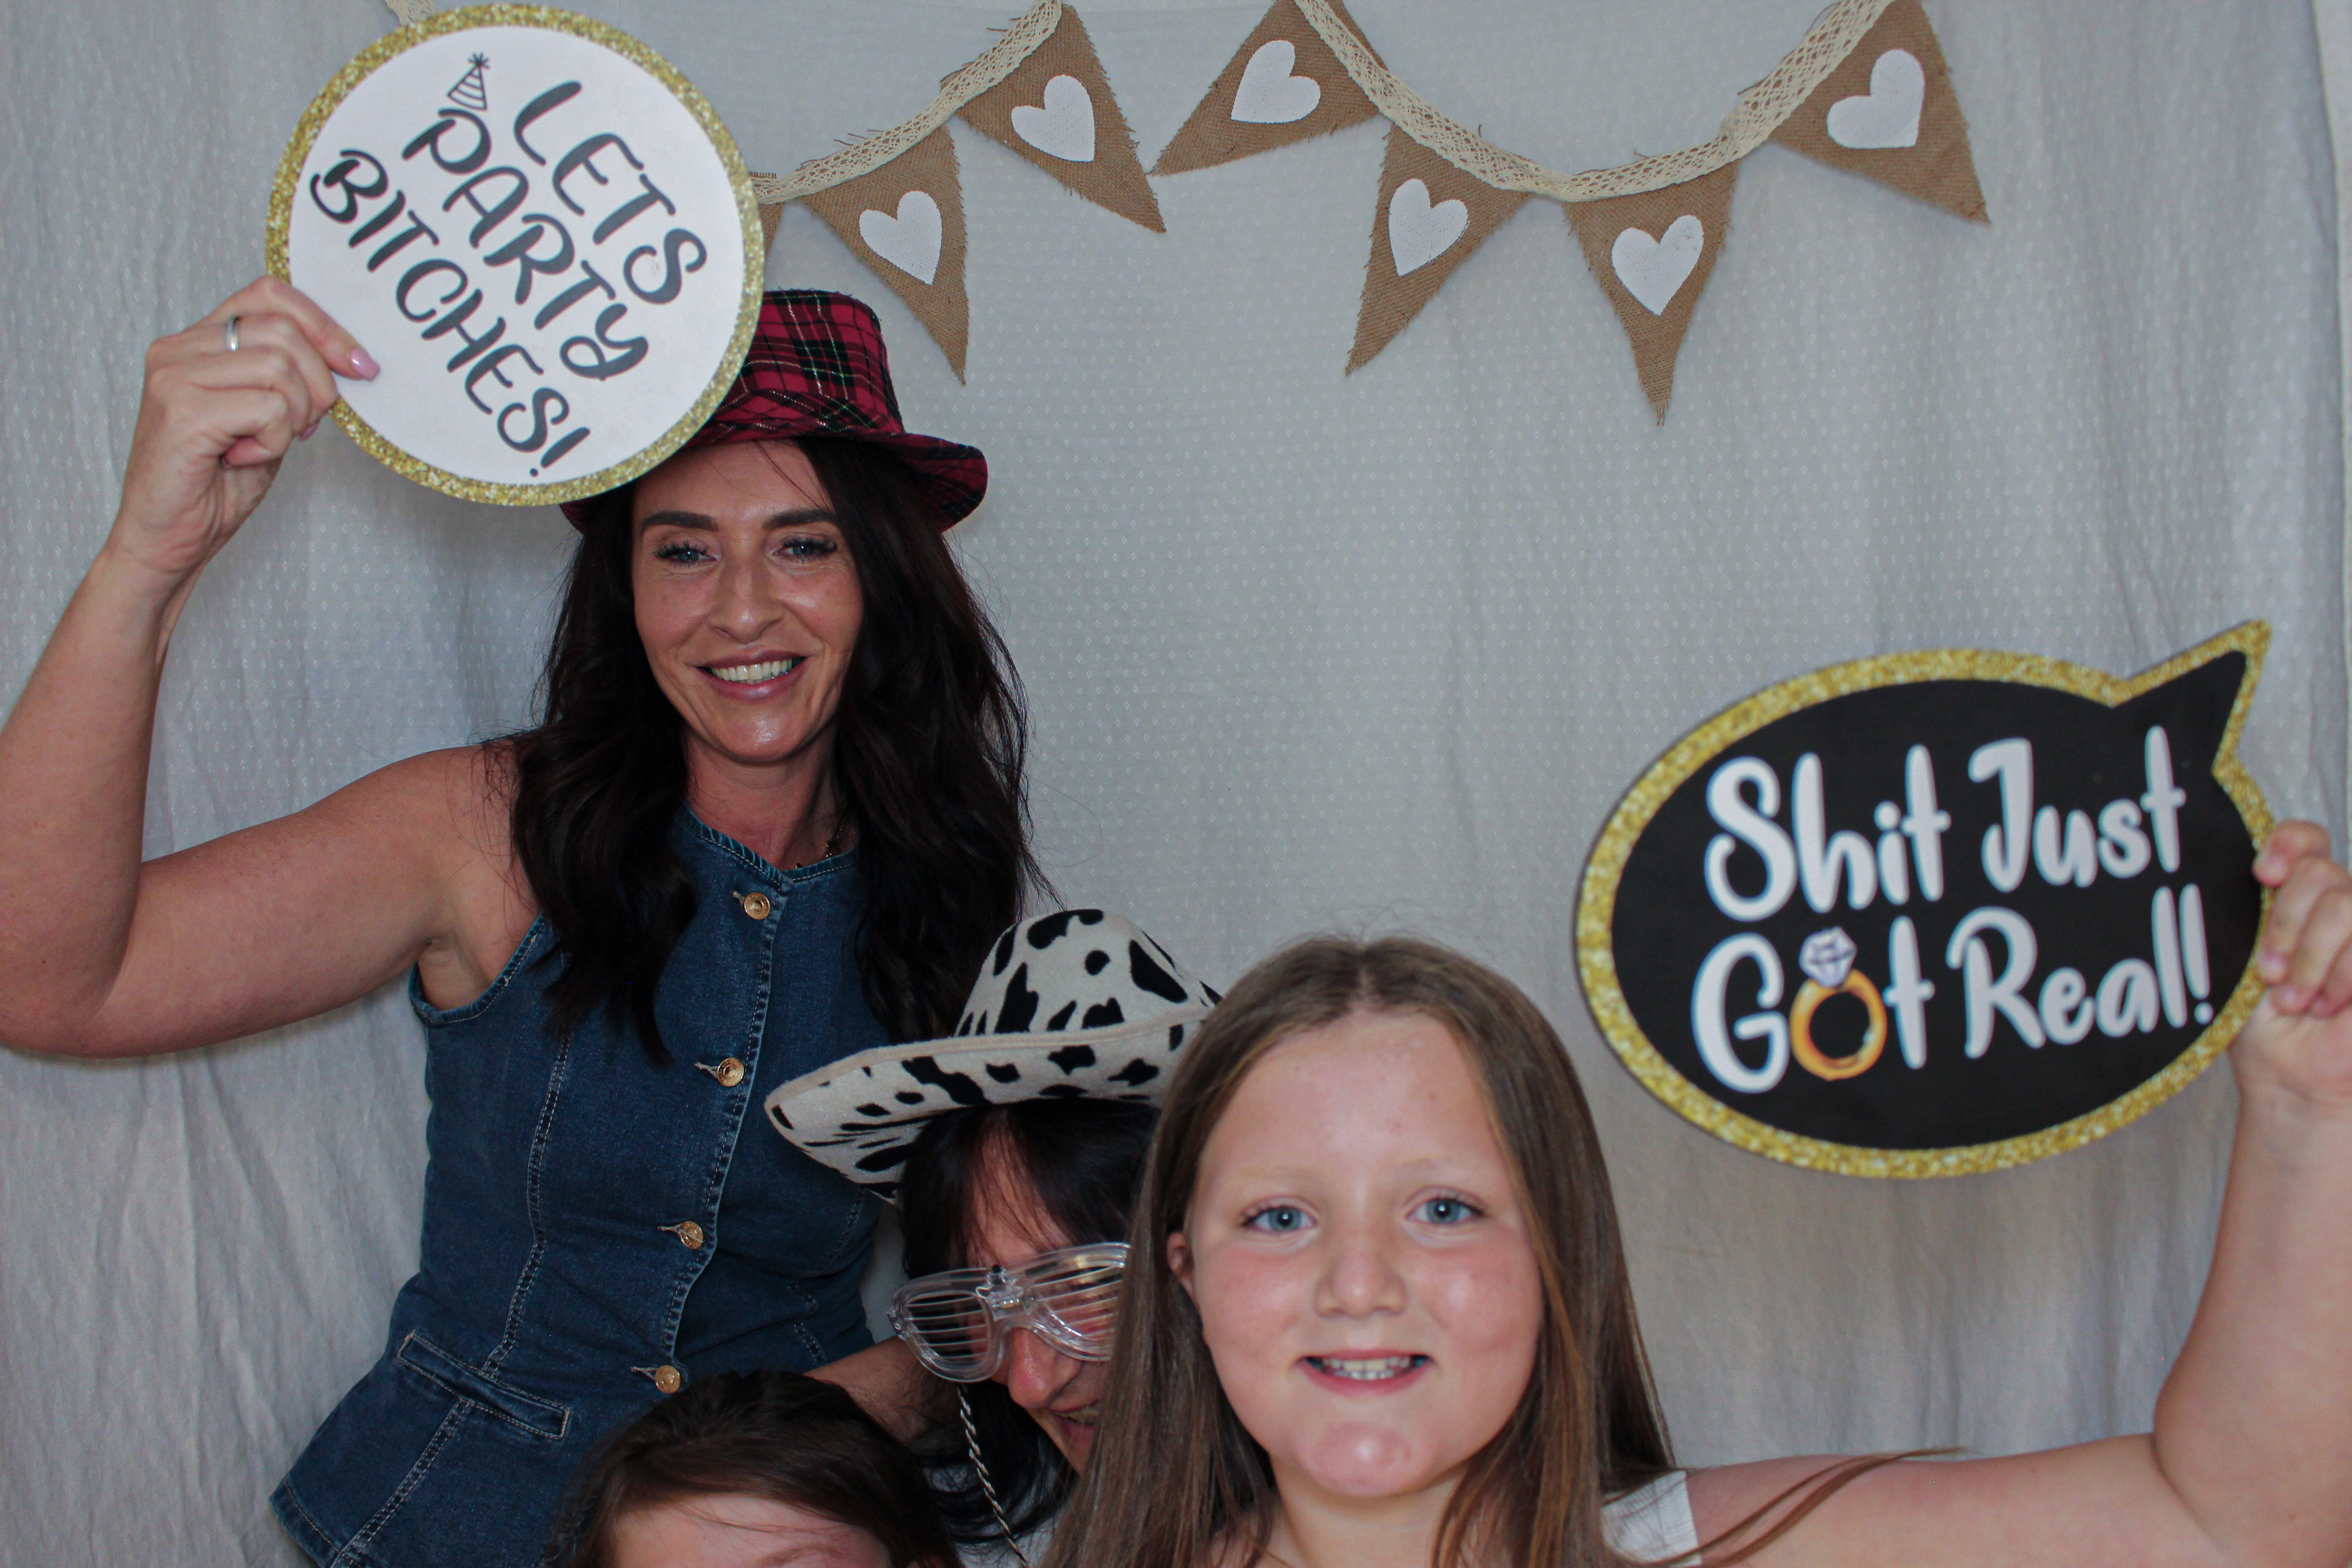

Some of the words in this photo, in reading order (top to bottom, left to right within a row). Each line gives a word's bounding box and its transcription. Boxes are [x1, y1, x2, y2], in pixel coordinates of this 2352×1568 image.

[401, 108, 649, 381] PARTY
[513, 81, 707, 305] LETS
[309, 149, 591, 478] BITCHES!
[1704, 744, 1951, 922] Shit
[1968, 726, 2186, 892] Just
[1691, 916, 1936, 1093] Got
[1946, 884, 2214, 1059] Real!
